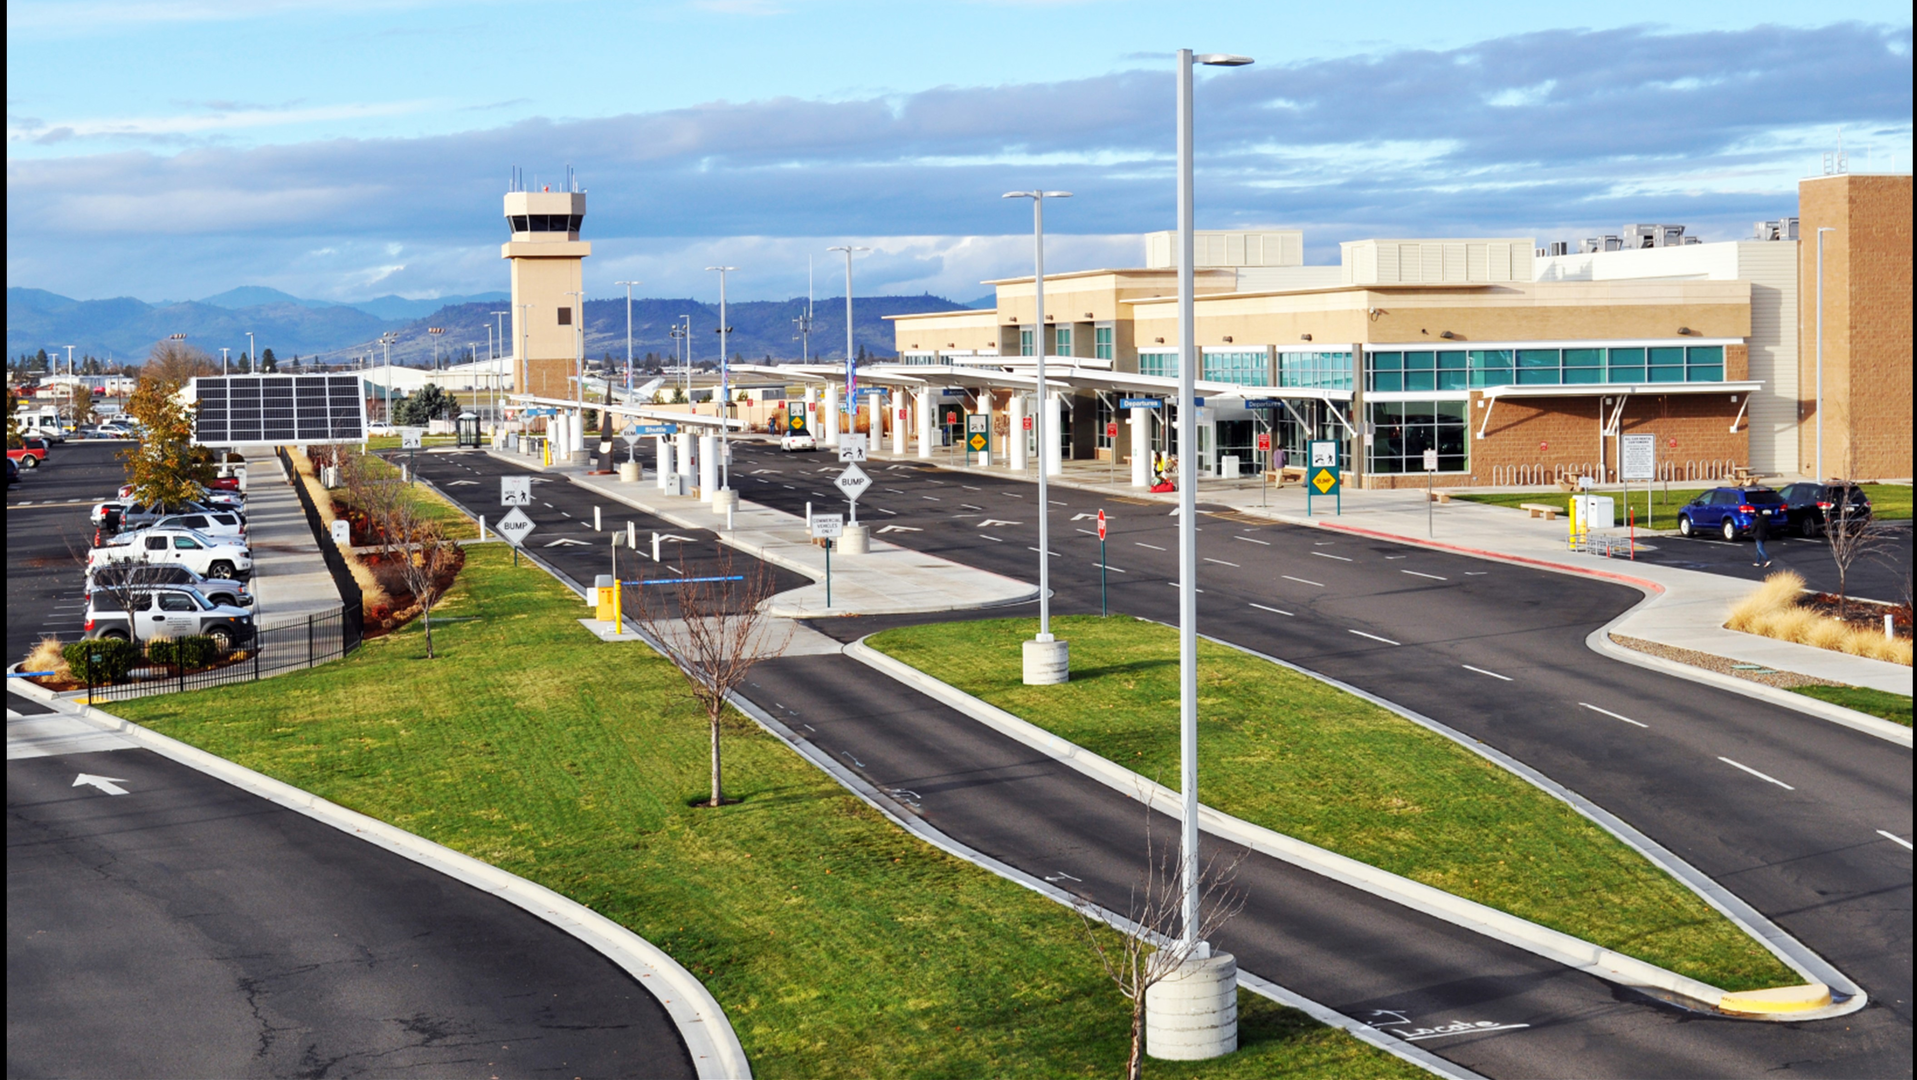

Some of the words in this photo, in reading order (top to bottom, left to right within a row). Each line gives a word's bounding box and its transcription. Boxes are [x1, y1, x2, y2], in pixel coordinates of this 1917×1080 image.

[842, 478, 864, 486] BUMP
[504, 522, 528, 530] BUMP
[1391, 1020, 1500, 1037] Locate
